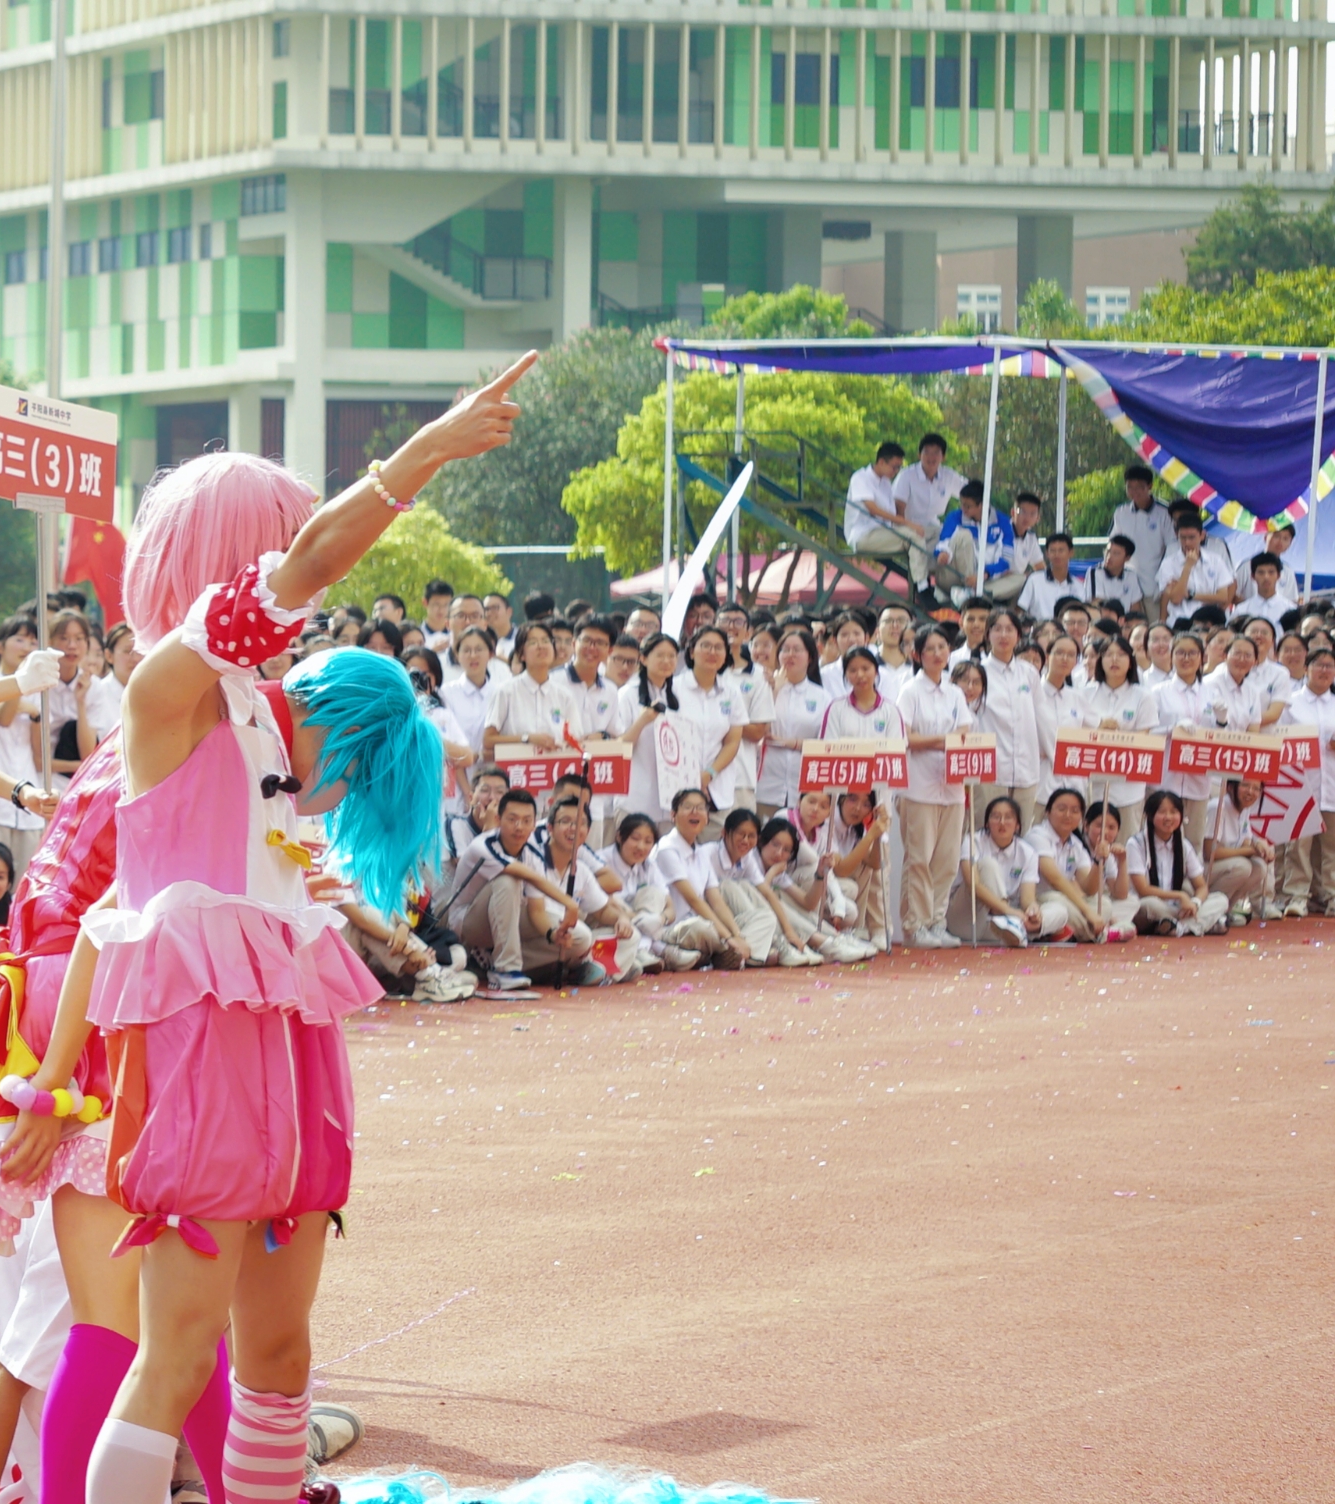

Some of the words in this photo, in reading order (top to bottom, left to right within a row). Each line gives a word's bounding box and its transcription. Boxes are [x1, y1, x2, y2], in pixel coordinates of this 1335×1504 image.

[807, 759, 868, 785] 高三(5)班
[950, 751, 992, 776] 高三(9)班
[1065, 747, 1153, 775] 高三(11)班
[1179, 744, 1272, 774] 高三(15)班
